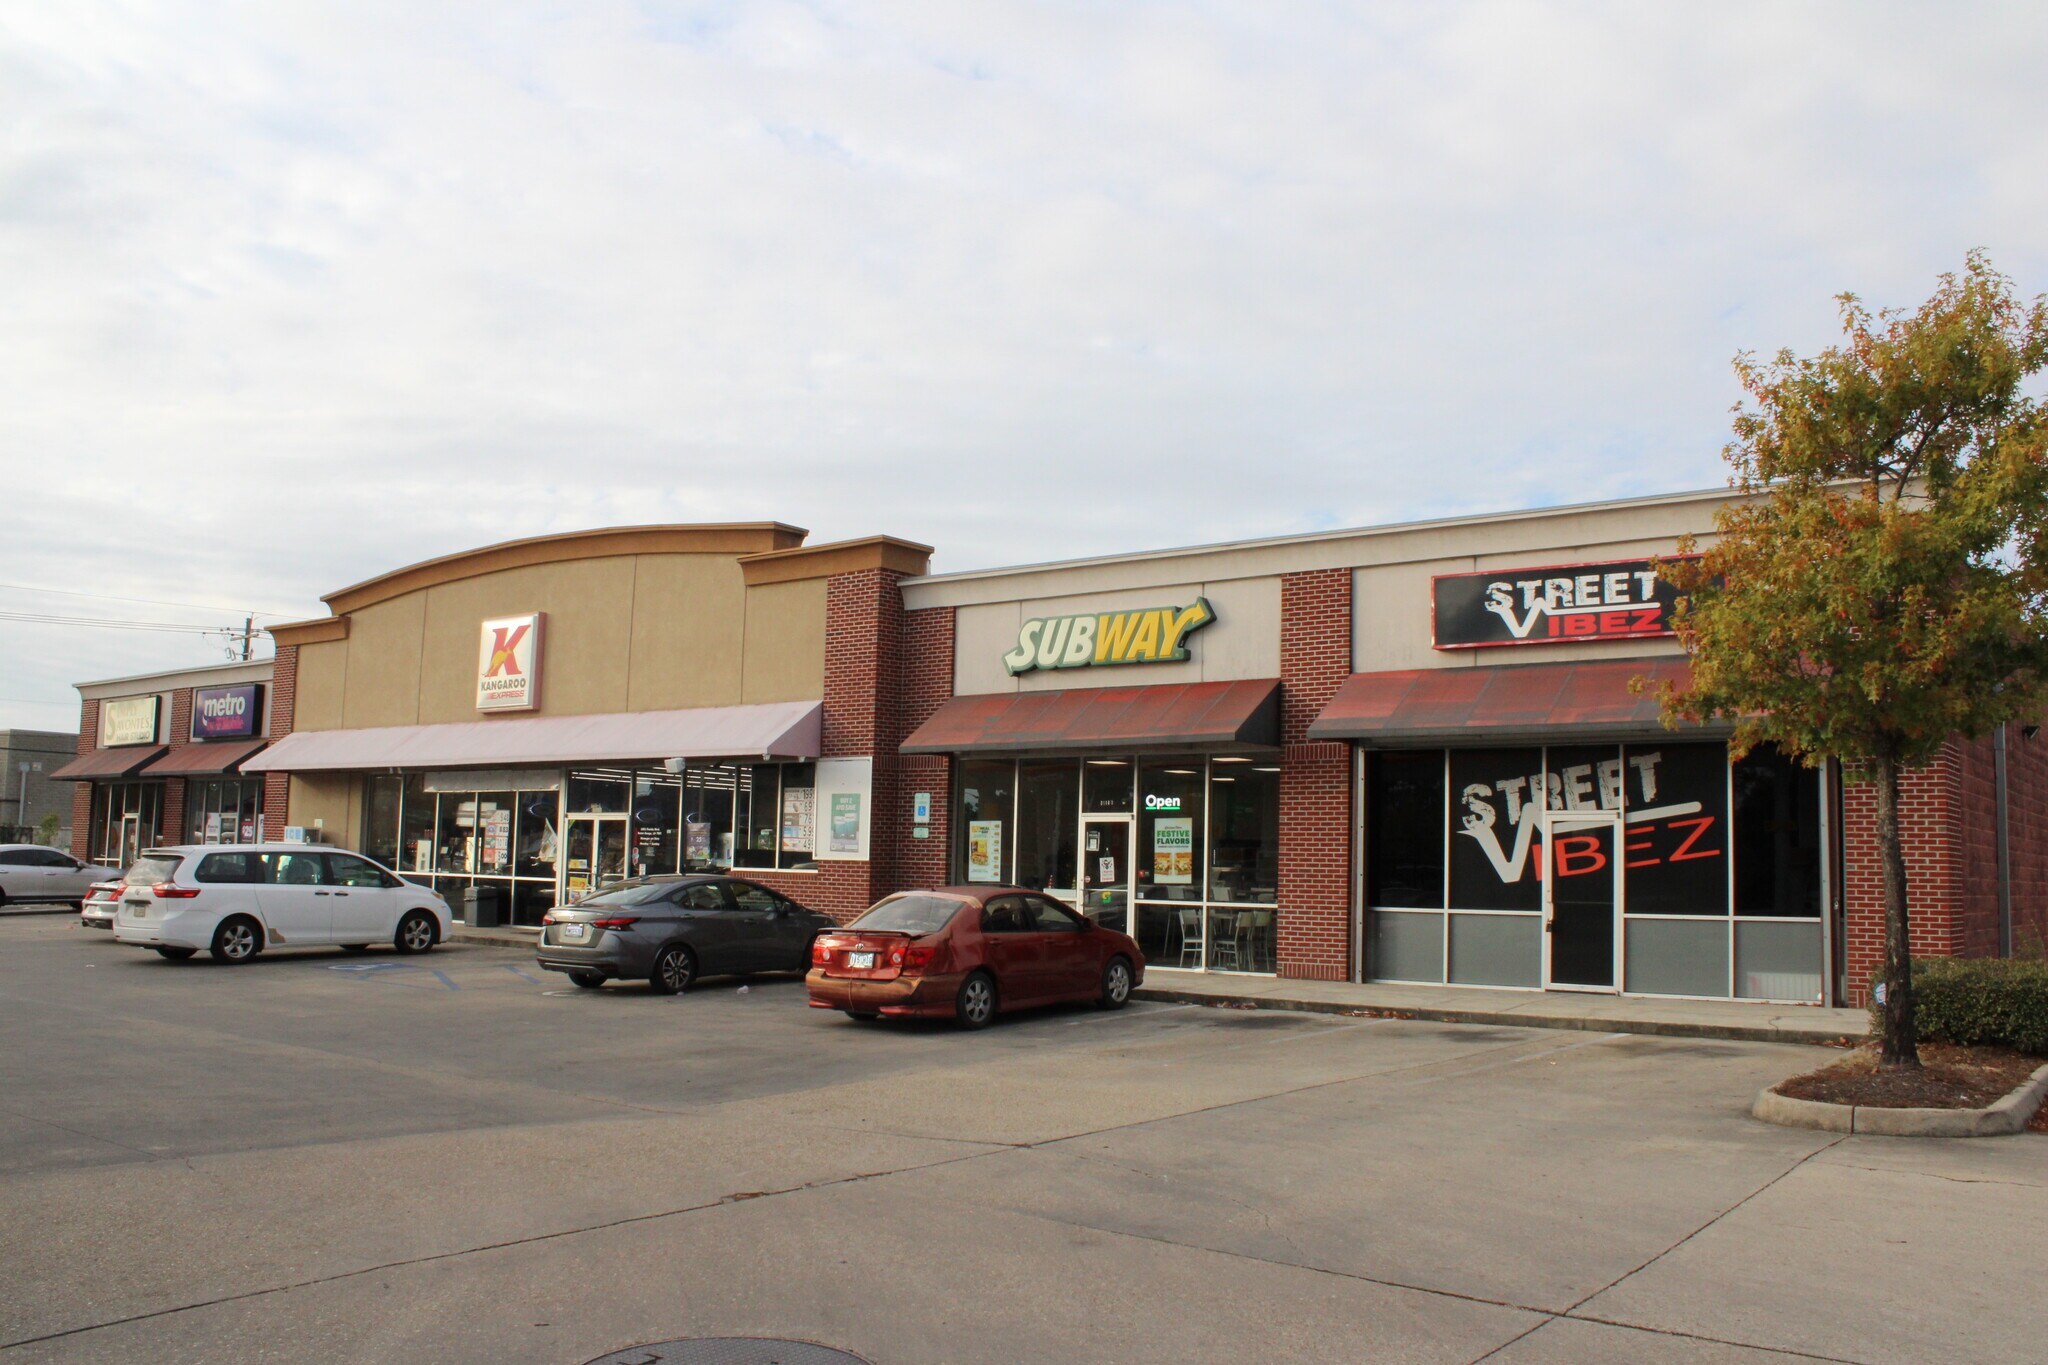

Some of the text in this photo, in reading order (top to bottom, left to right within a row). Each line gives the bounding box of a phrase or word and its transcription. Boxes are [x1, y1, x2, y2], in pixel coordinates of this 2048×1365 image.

[1484, 571, 1657, 611] STREET
[1004, 603, 1206, 669] SUBWAY
[1496, 598, 1661, 638] VIBEZ
[484, 624, 531, 678] K
[481, 678, 526, 691] KANGAROO
[490, 690, 525, 699] EXPRESS
[203, 693, 245, 718] metro
[1145, 794, 1180, 810] Open
[1462, 752, 1661, 832] STREET
[1457, 801, 1720, 883] VIBEZ
